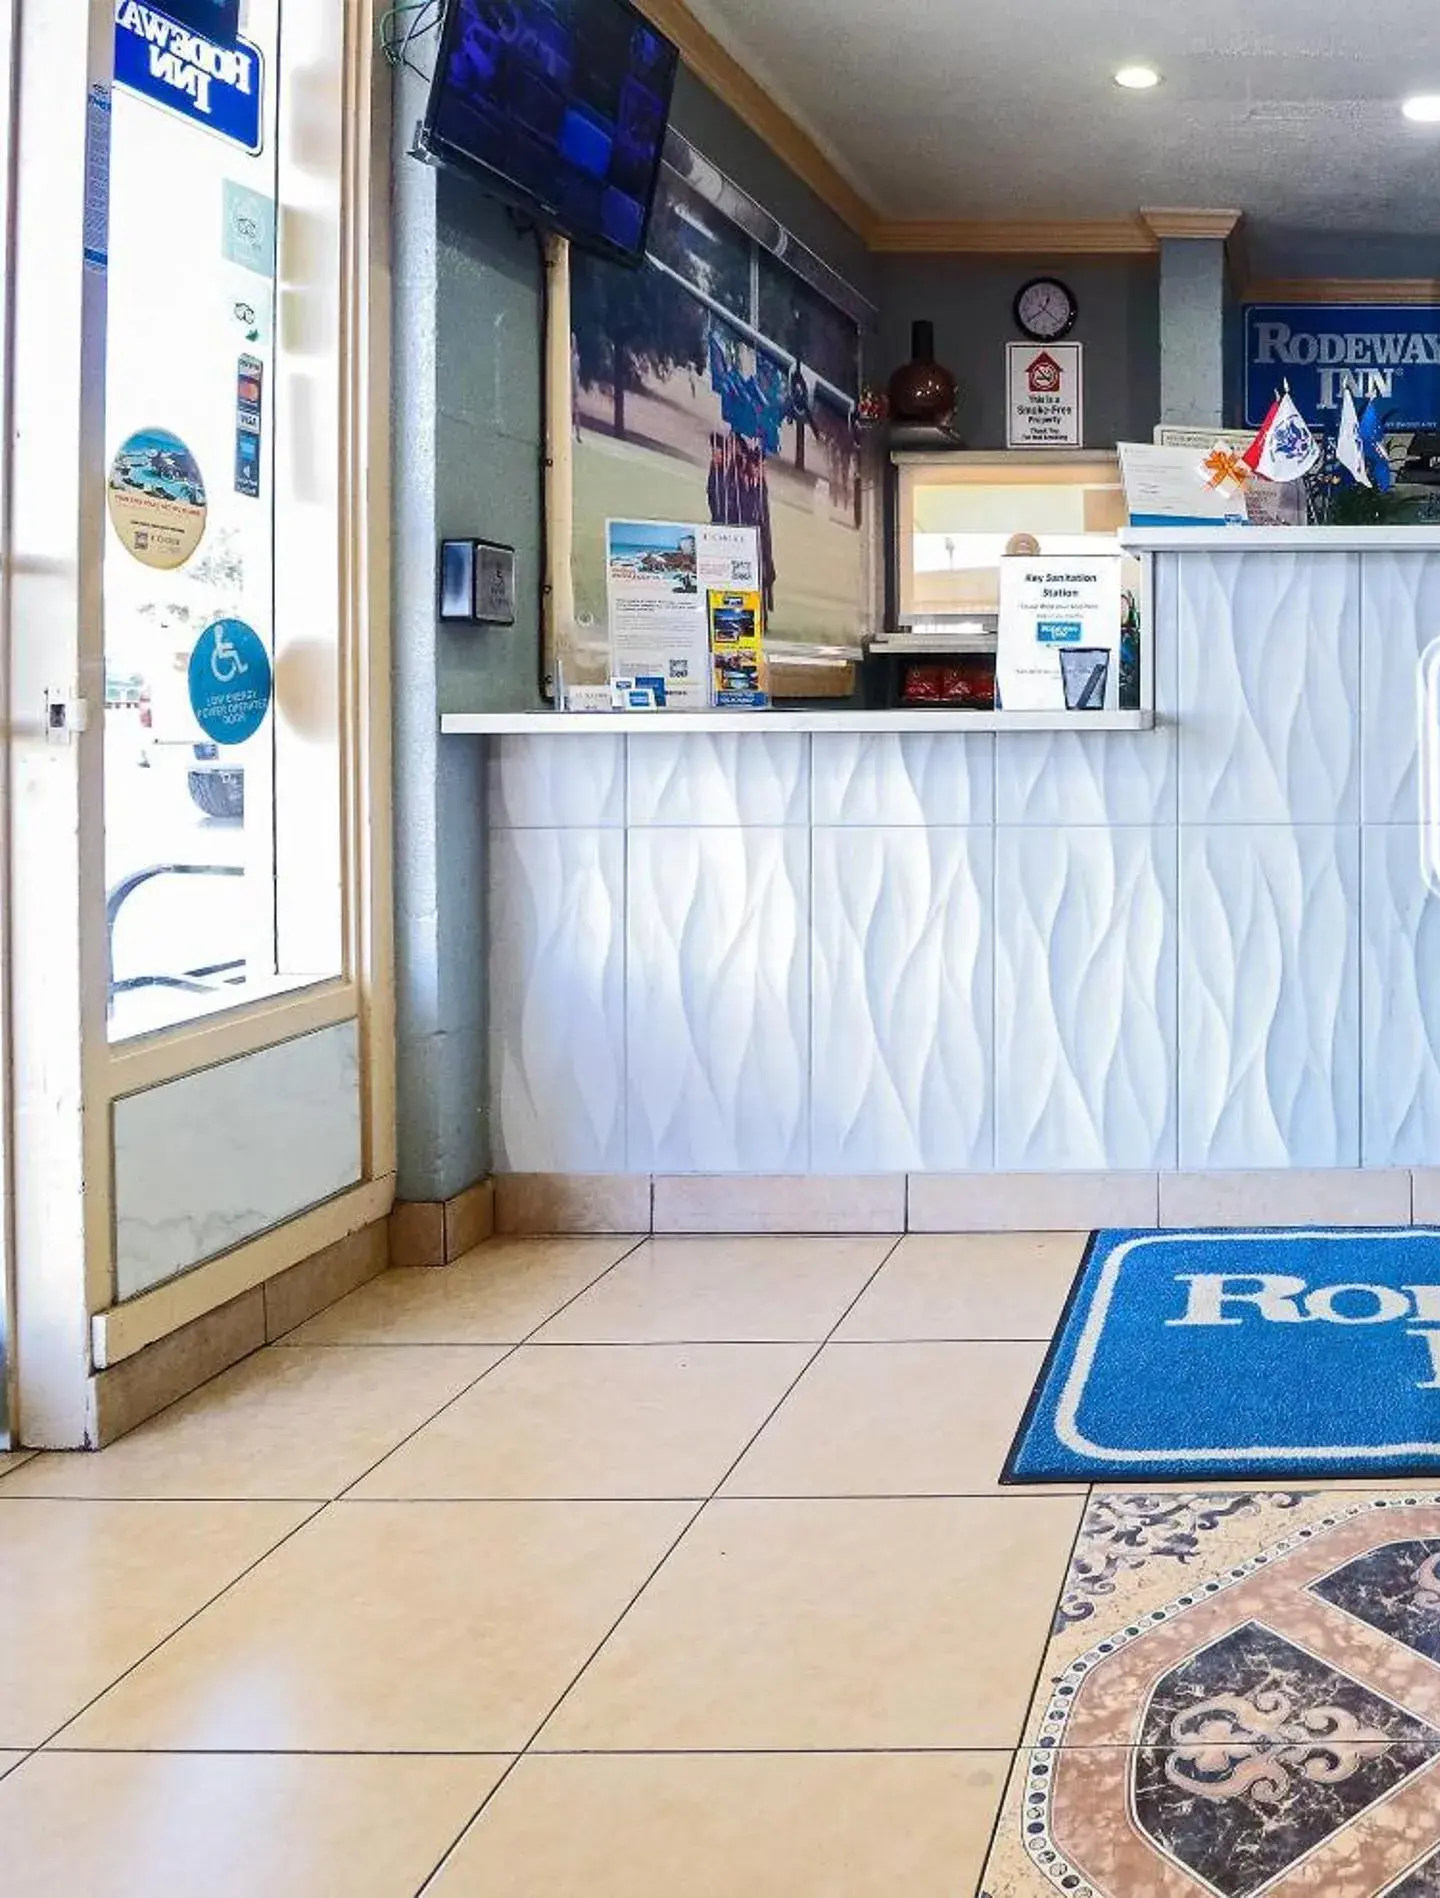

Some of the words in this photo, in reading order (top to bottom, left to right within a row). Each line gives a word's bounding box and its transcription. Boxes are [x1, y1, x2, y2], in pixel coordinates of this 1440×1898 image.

[1316, 367, 1394, 410] INN
[1025, 574, 1044, 583] Key
[1046, 573, 1097, 583] Sanitation
[1043, 588, 1079, 598] Station
